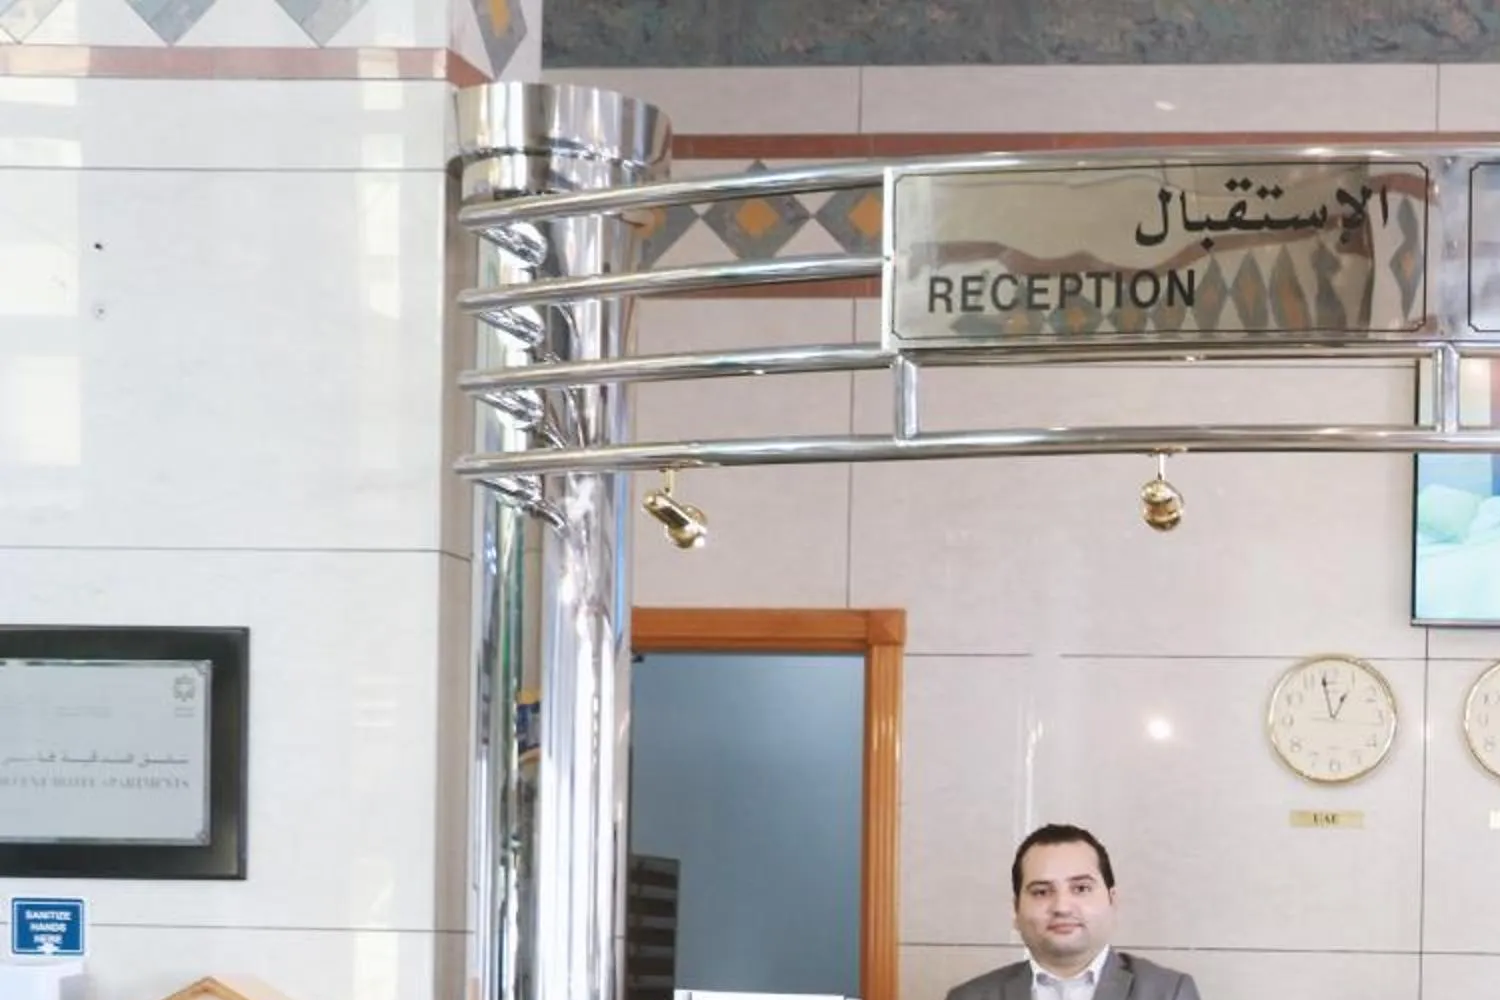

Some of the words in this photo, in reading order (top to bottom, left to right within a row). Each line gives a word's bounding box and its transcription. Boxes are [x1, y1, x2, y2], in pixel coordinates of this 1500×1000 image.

[928, 269, 1197, 313] RECEPTION
[26, 910, 72, 921] SANITIZE
[30, 922, 67, 933] HANDS
